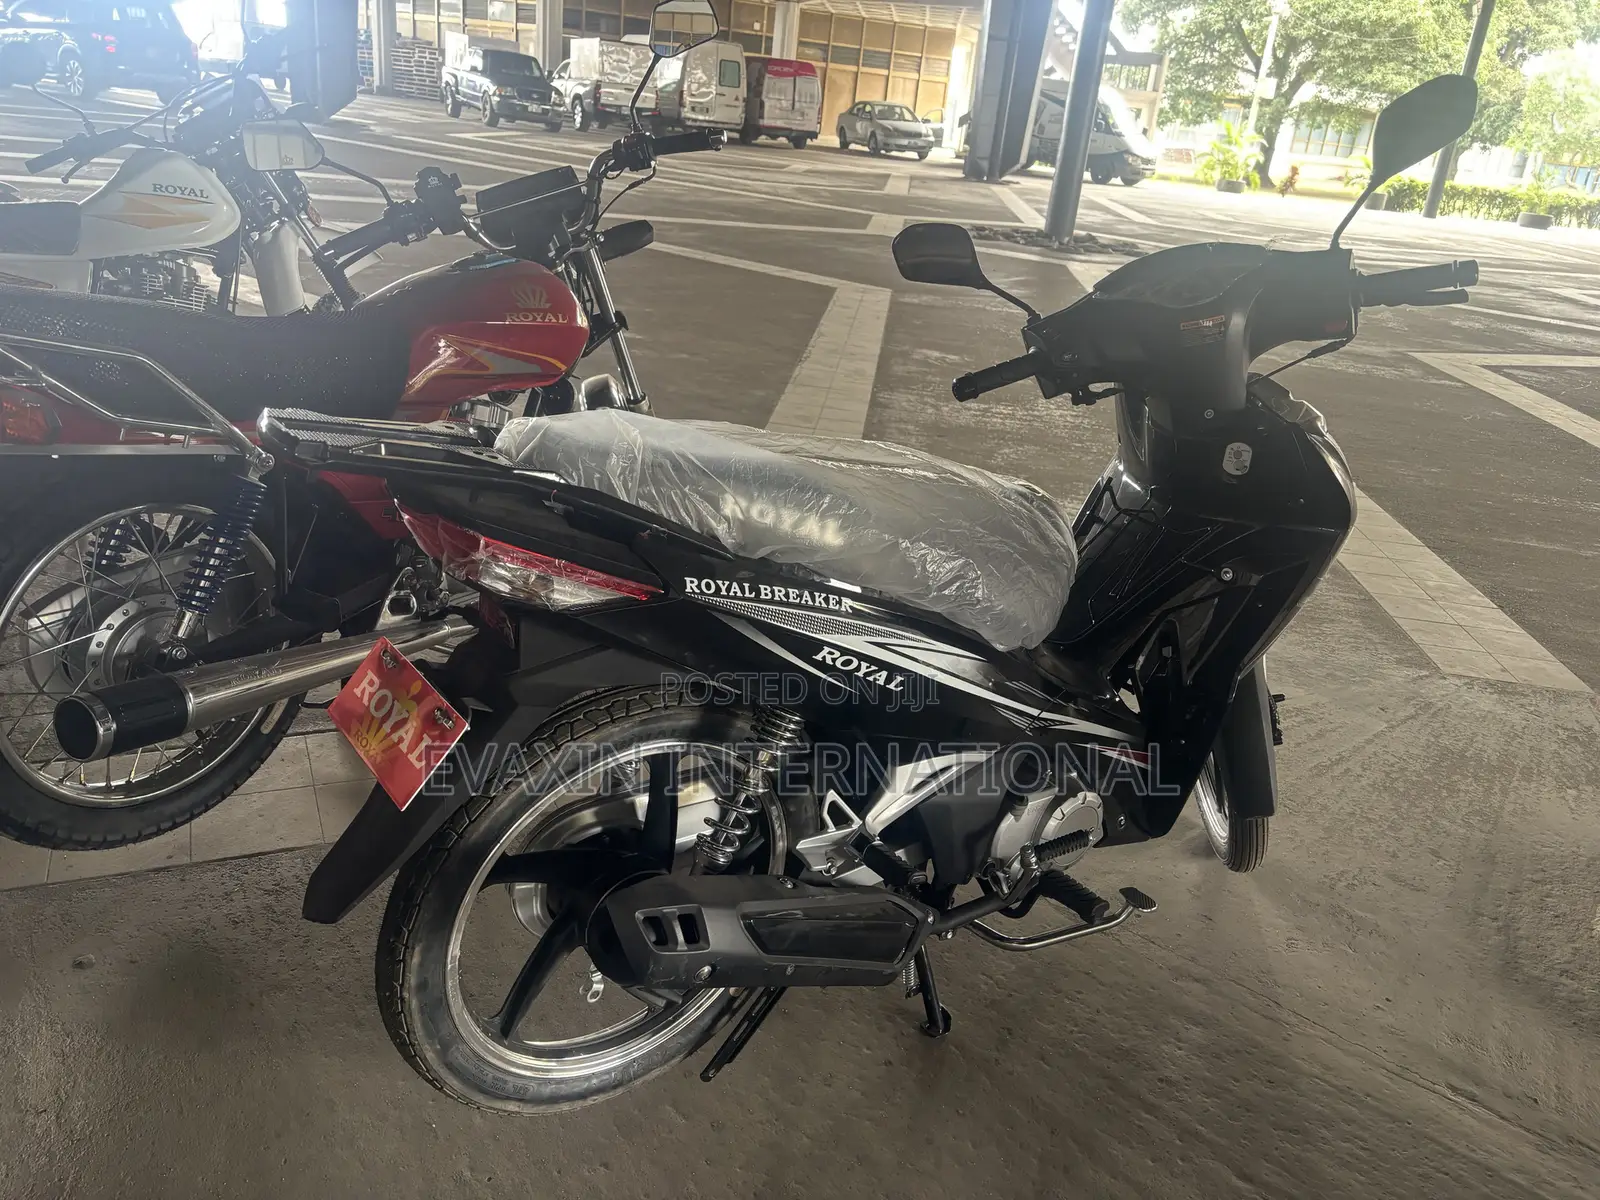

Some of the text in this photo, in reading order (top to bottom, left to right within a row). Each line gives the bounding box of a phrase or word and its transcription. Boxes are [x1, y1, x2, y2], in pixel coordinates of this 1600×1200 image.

[152, 183, 208, 199] ROYAL
[504, 312, 569, 323] ROYAL
[684, 577, 853, 613] ROYAL BREAKER
[812, 646, 905, 691] ROYAL
[353, 669, 432, 769] ROYAL
